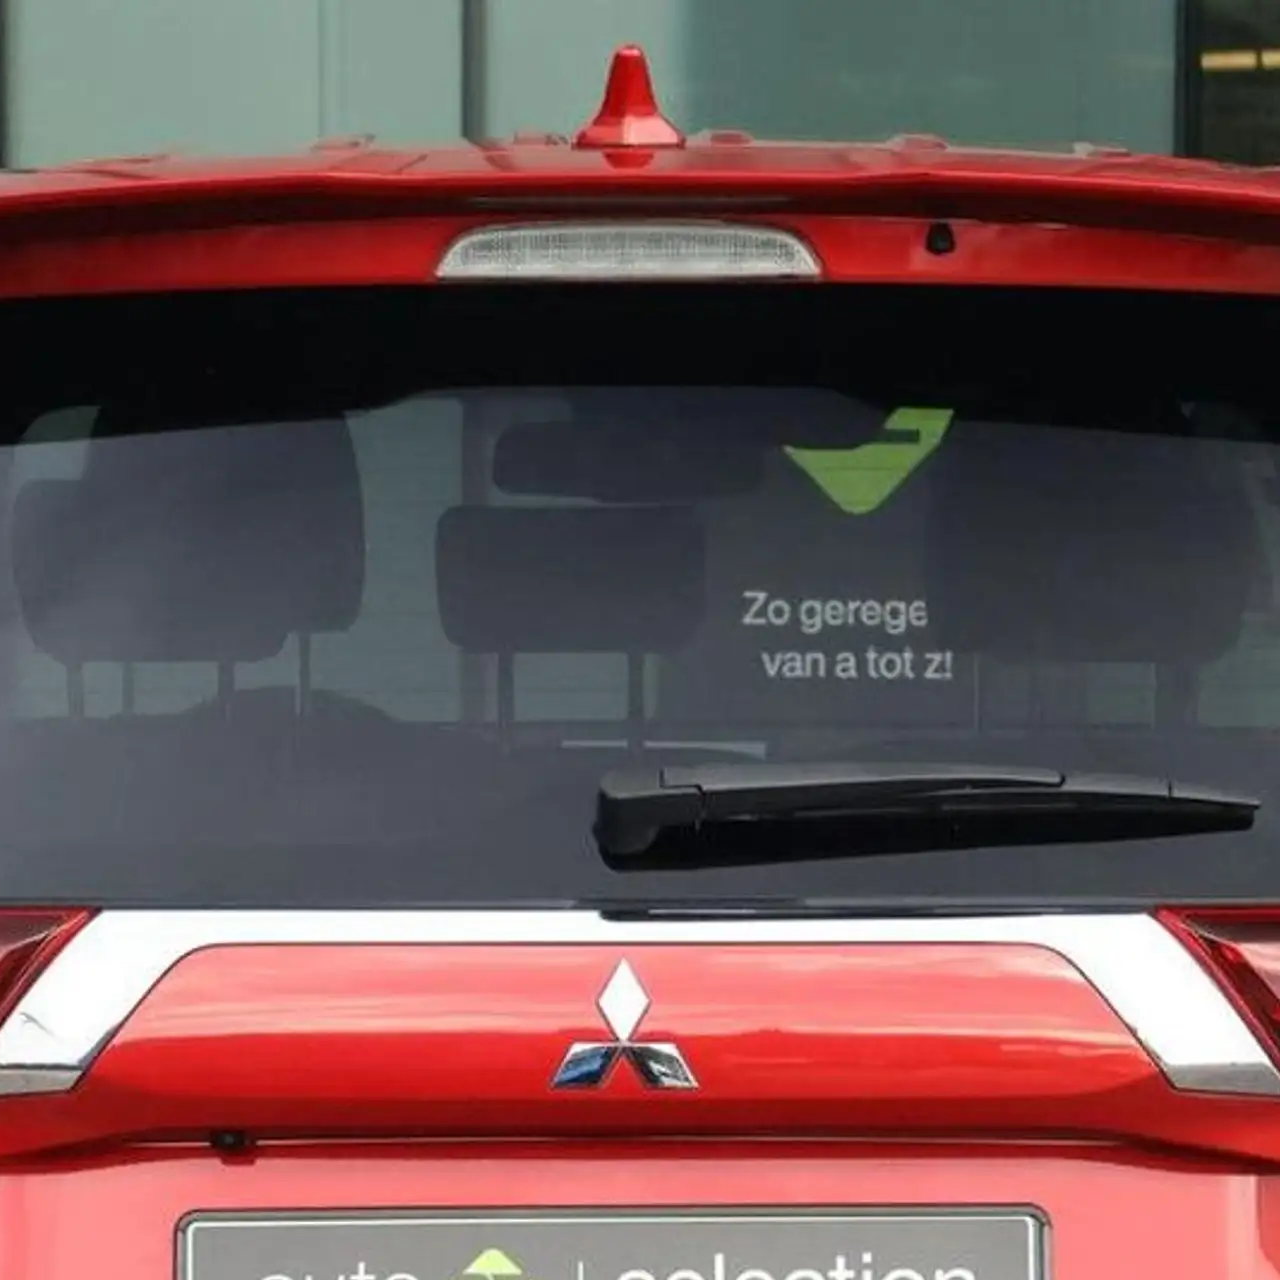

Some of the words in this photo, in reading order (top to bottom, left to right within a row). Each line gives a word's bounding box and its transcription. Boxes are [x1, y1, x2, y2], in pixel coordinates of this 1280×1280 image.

[742, 591, 790, 625] Zo
[799, 598, 928, 634] gerege
[761, 651, 825, 677] van
[834, 651, 858, 677] a
[865, 645, 914, 679] tot
